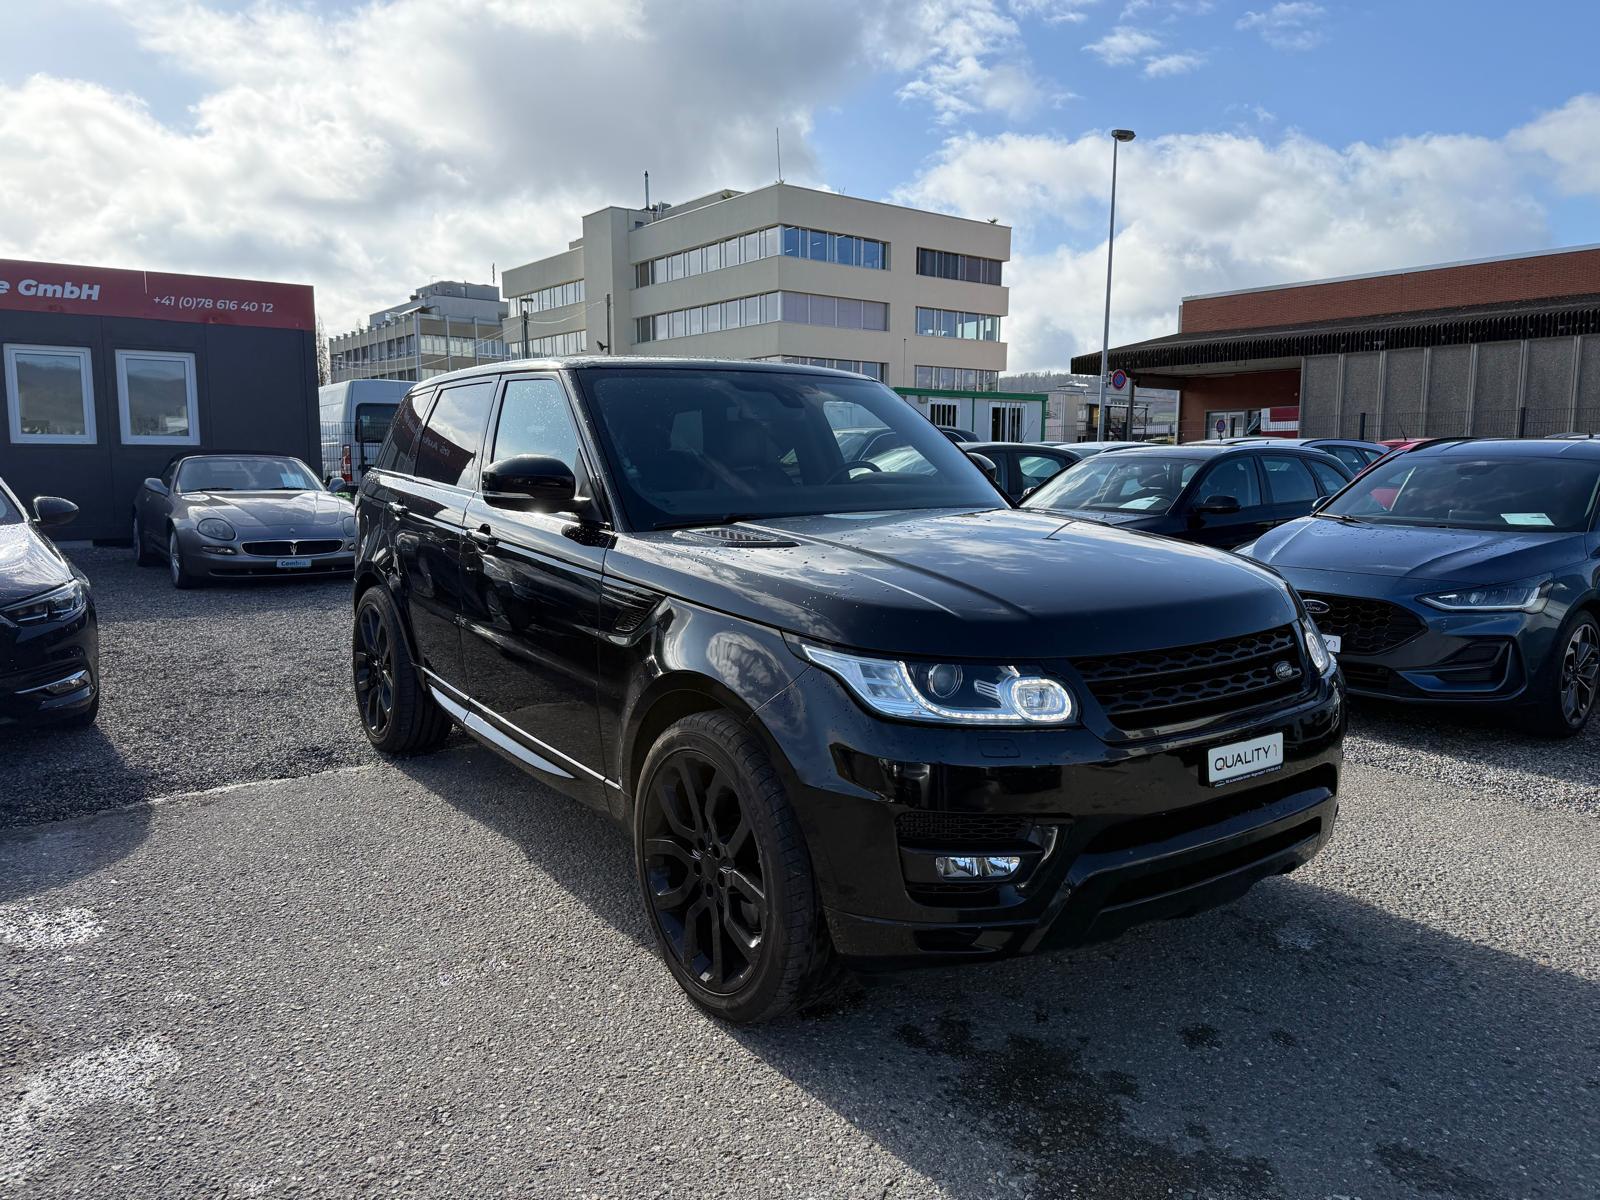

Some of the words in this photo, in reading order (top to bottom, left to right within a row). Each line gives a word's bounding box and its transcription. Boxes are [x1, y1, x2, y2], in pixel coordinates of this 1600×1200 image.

[18, 279, 100, 300] GmbH
[153, 296, 175, 306] +41
[179, 296, 213, 309] (0)78
[216, 299, 238, 311] 616
[240, 301, 258, 312] 40
[261, 302, 273, 313] 12
[1214, 744, 1271, 771] QUALITY
